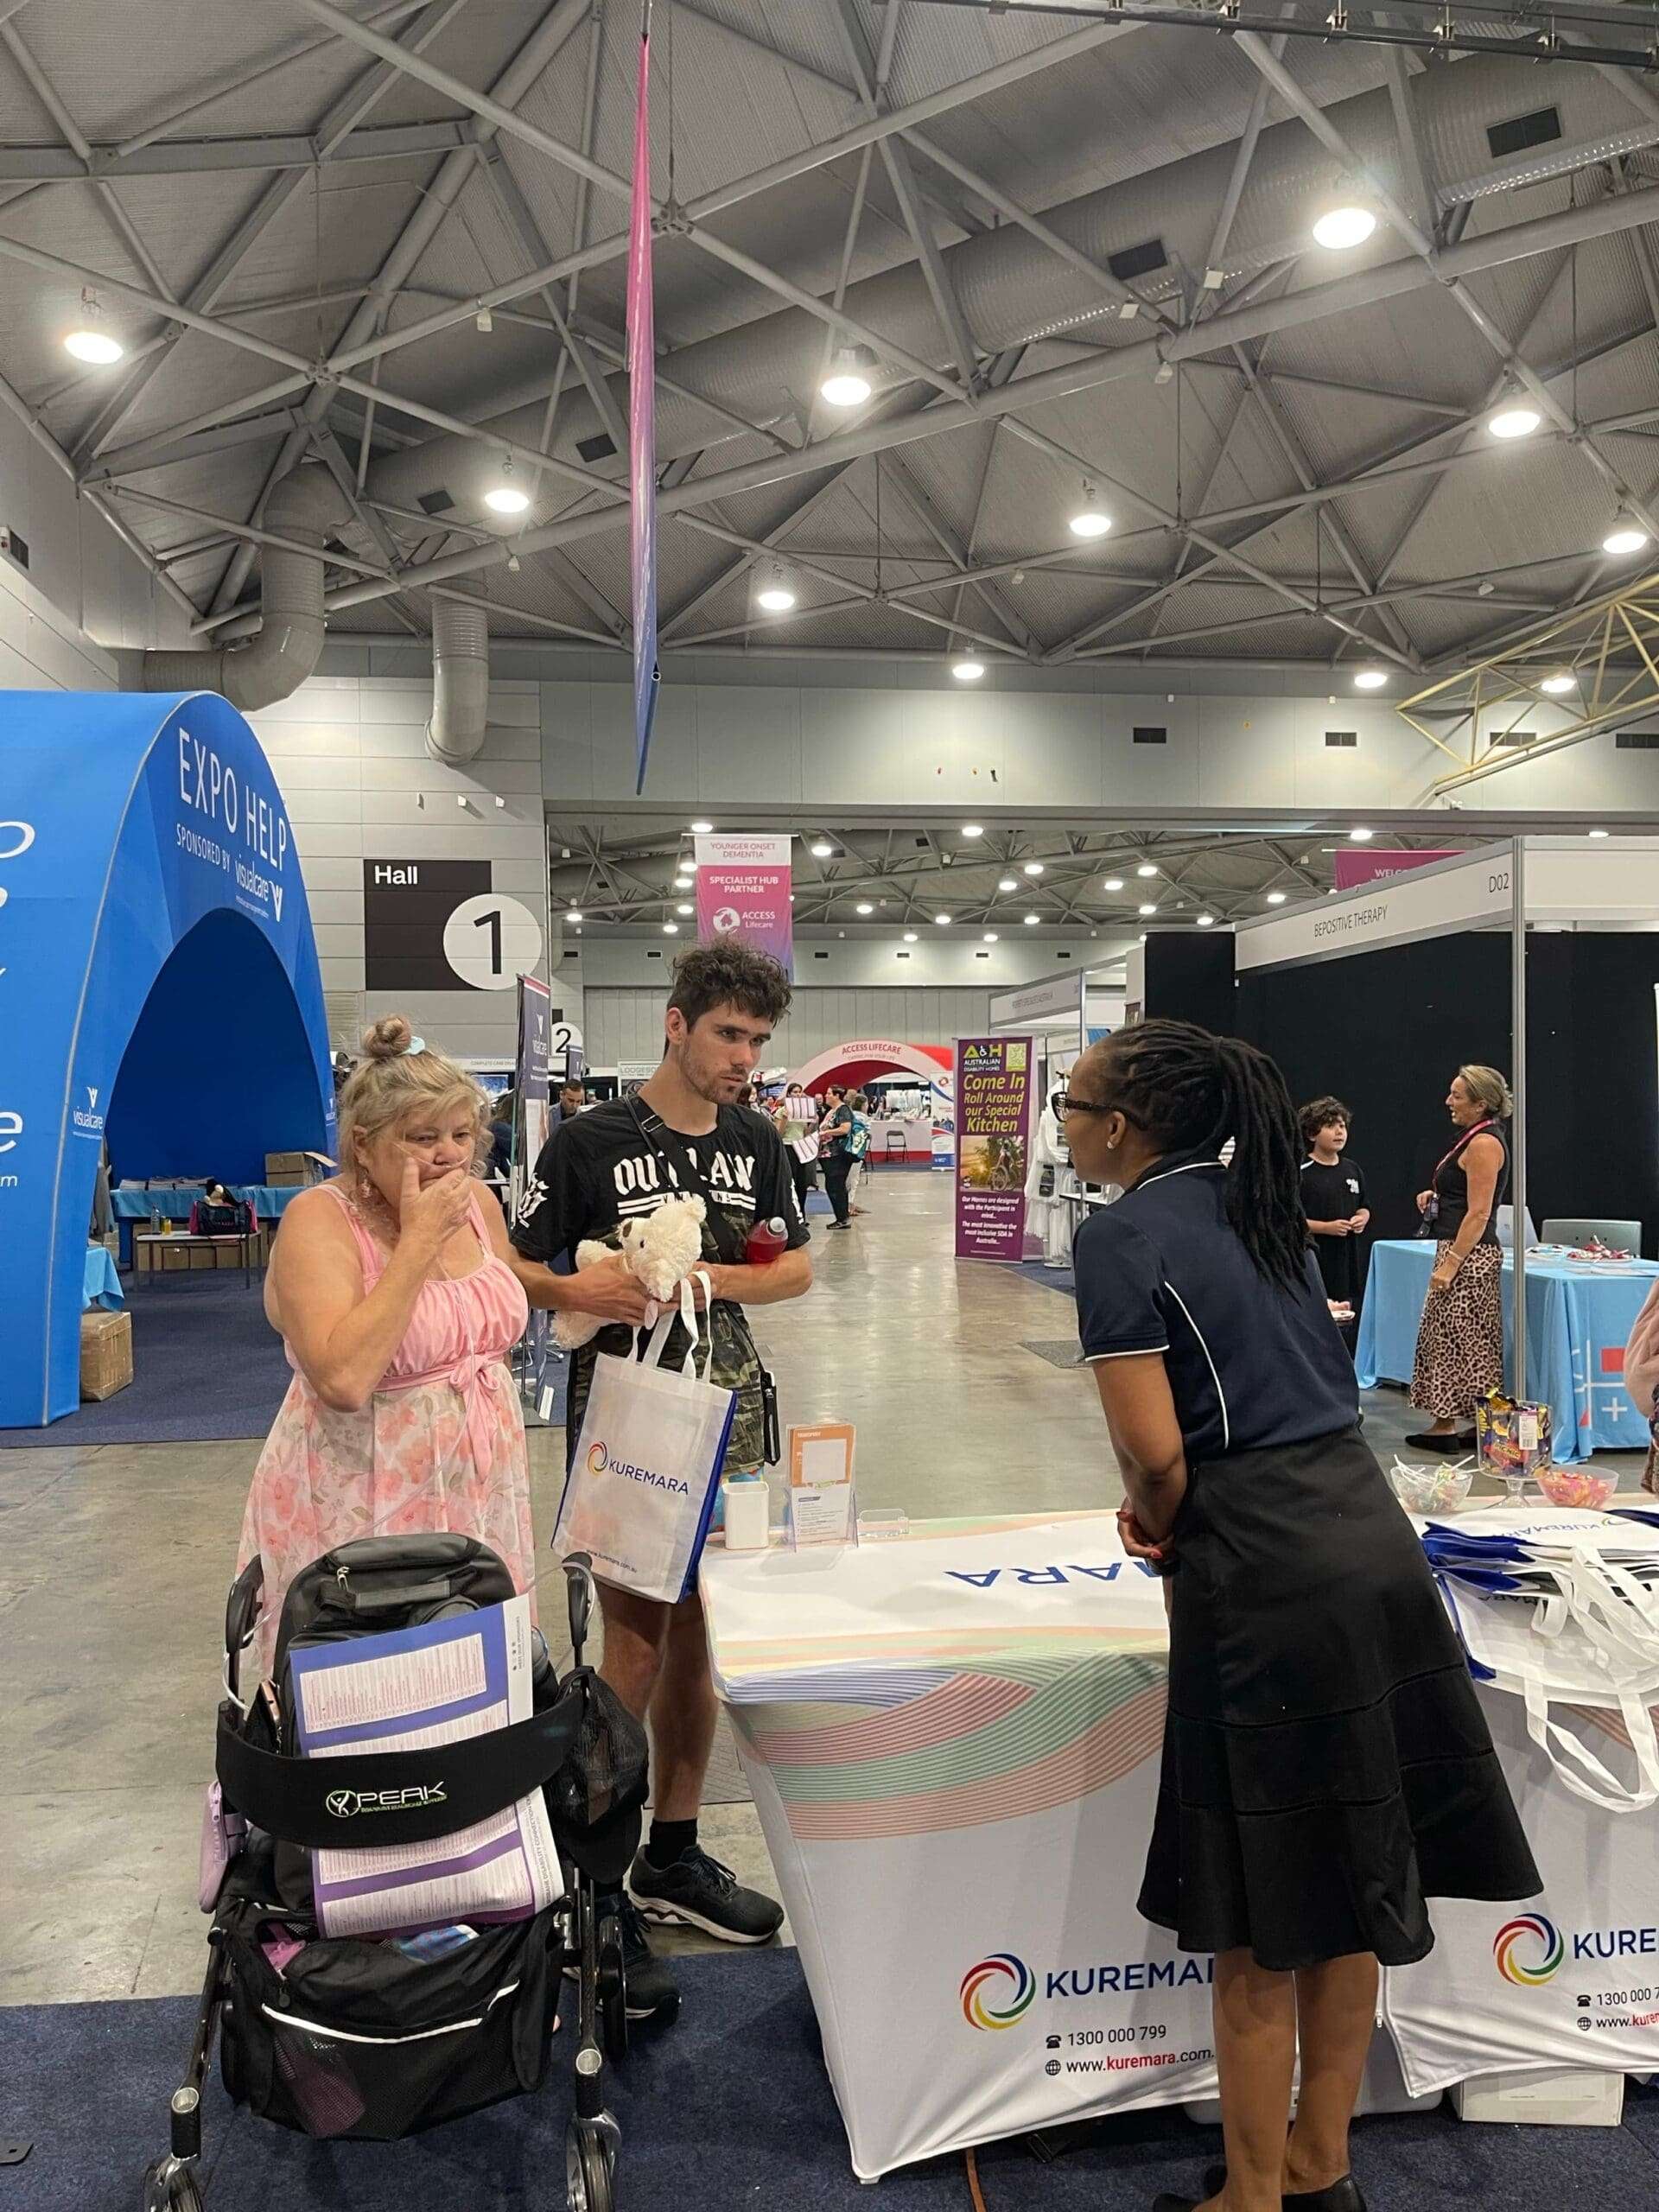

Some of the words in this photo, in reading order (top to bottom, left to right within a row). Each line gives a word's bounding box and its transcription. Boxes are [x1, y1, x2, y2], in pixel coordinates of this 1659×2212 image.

[179, 728, 238, 834] EXPO
[245, 785, 287, 872] HELP
[176, 823, 220, 866] SPONSORED
[222, 849, 230, 873] BY
[234, 855, 269, 901] visualcare
[374, 865, 418, 886] Hall
[709, 876, 758, 885] SPECIALIST
[760, 876, 779, 885] HUB
[1489, 873, 1510, 893] D02
[724, 885, 765, 893] PARTNER
[745, 920, 774, 929] Lifecare
[1314, 915, 1353, 938] BEPOSITIVE
[1354, 905, 1389, 927] THERAPY
[473, 910, 503, 976] 1
[556, 1028, 571, 1053] 2
[842, 1044, 868, 1054] ACCESS
[868, 1043, 902, 1054] LIFECARE
[963, 1074, 1006, 1090] Come
[1009, 1073, 1025, 1090] In
[963, 1092, 982, 1104] Roll
[984, 1091, 1025, 1104] Around
[73, 1106, 104, 1130] visualcare
[965, 1107, 983, 1116] our
[984, 1103, 1021, 1118] Special
[967, 1116, 1018, 1132] Kitchen
[1494, 1442, 1520, 1459] PICNIC
[608, 1459, 690, 1495] KUREMARA
[357, 1781, 446, 1808] PEAK
[1597, 1992, 1628, 2006] 1300
[1630, 1987, 1651, 2002] 000
[1067, 2030, 1103, 2047] 1300
[1108, 2027, 1135, 2044] 000
[1140, 2024, 1167, 2043] 799
